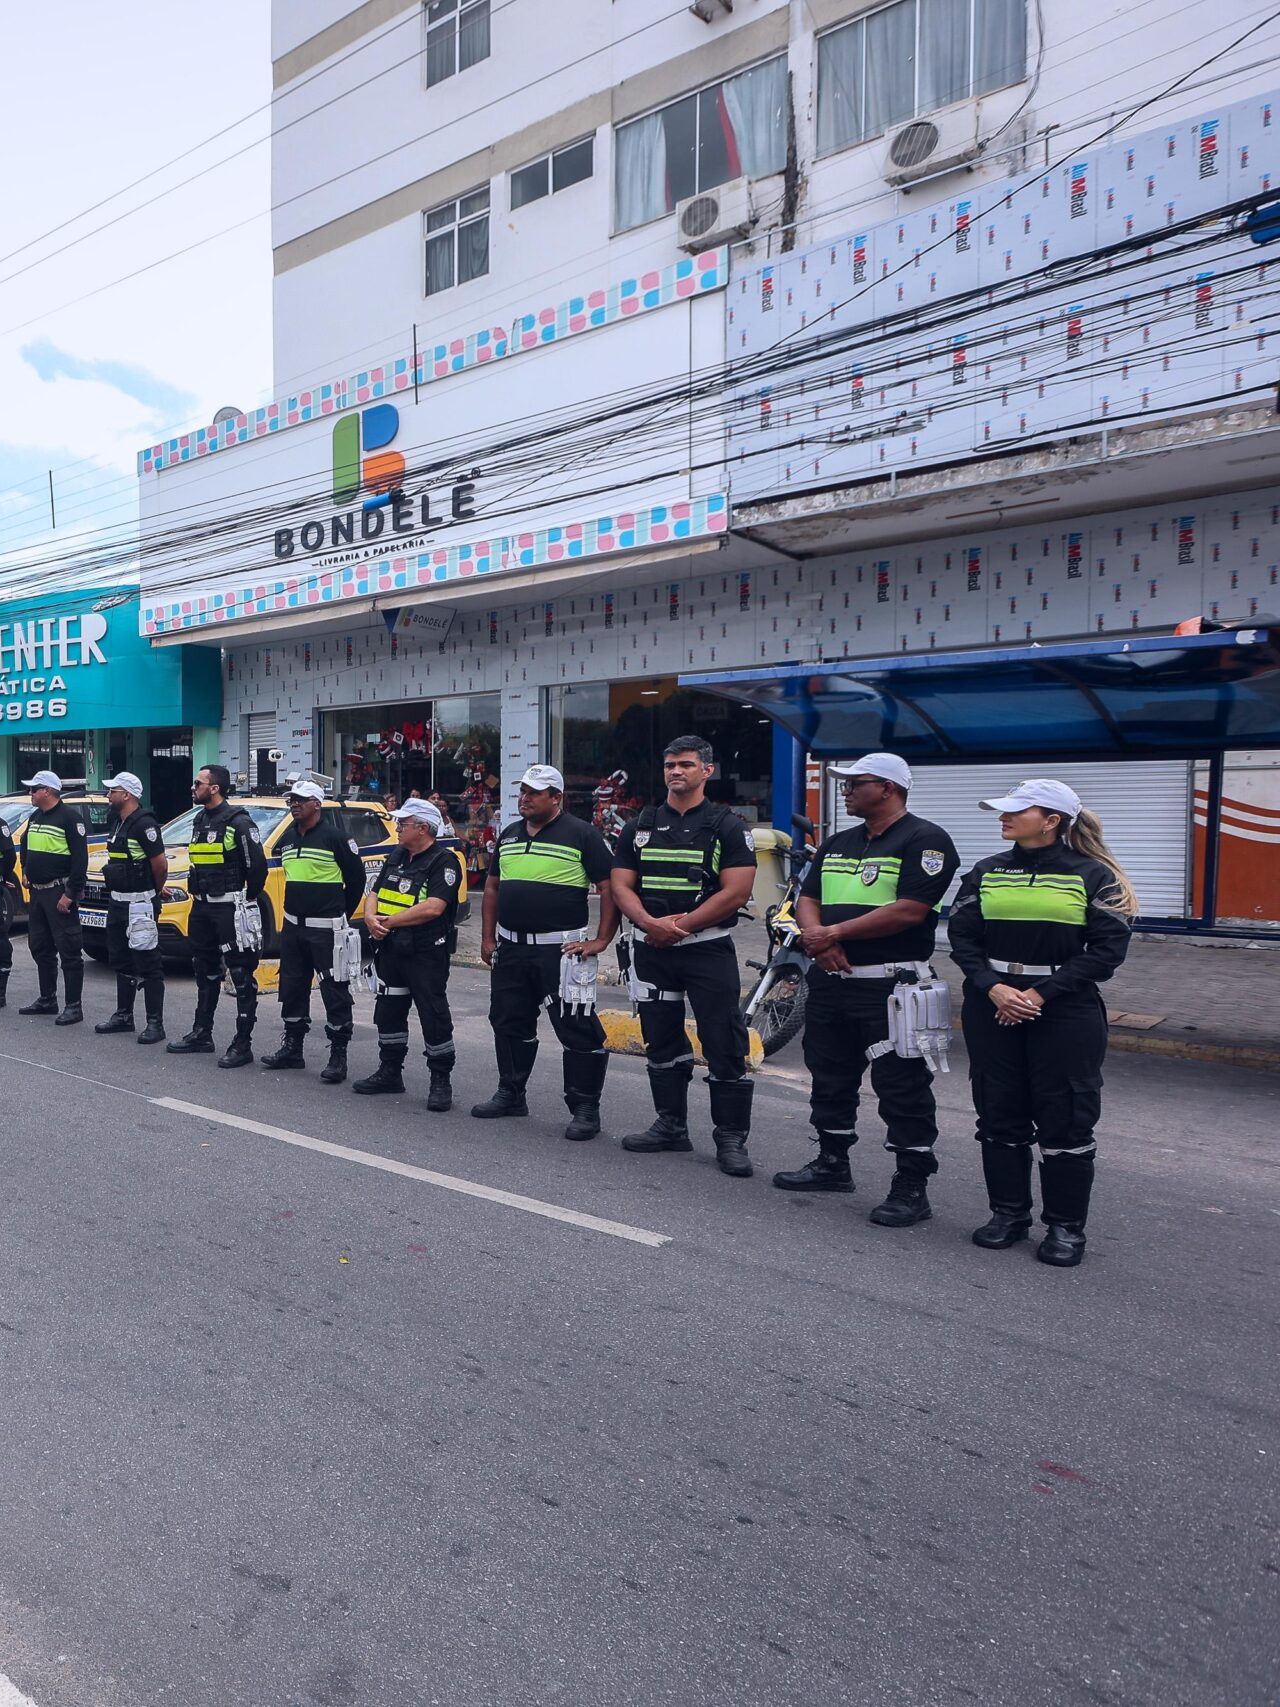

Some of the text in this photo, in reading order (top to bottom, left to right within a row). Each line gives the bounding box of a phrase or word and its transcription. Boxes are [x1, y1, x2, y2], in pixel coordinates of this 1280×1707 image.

[1199, 119, 1220, 180] AluMBrasil
[1070, 162, 1088, 219] AluMBrasil
[319, 538, 425, 567] LIVRARIA & PAPELARIA
[1067, 533, 1083, 579] AluMBrasil
[1178, 515, 1196, 566] AluMBrasil
